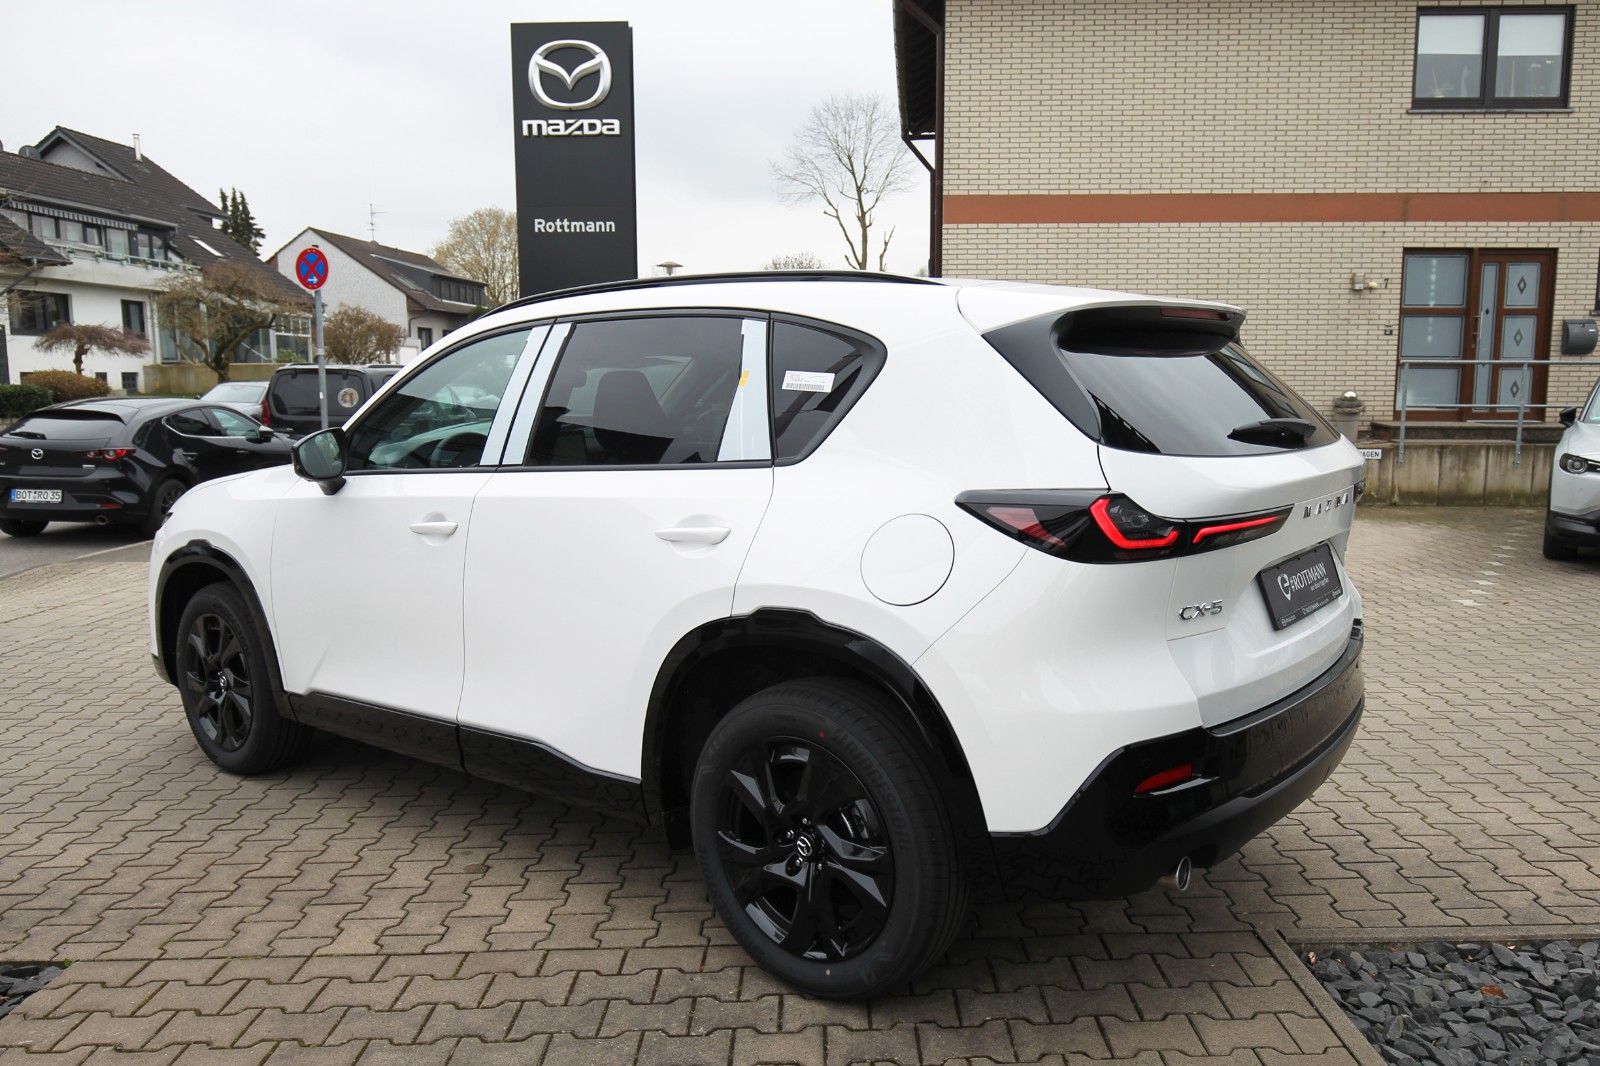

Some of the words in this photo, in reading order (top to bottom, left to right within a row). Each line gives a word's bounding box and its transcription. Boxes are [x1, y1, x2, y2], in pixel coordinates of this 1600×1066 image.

[534, 218, 616, 233] Rottmann
[16, 490, 32, 500] BOT
[37, 490, 48, 500] RO
[50, 491, 61, 500] 35
[1303, 492, 1349, 518] MAZDA
[1179, 600, 1223, 620] CX-5
